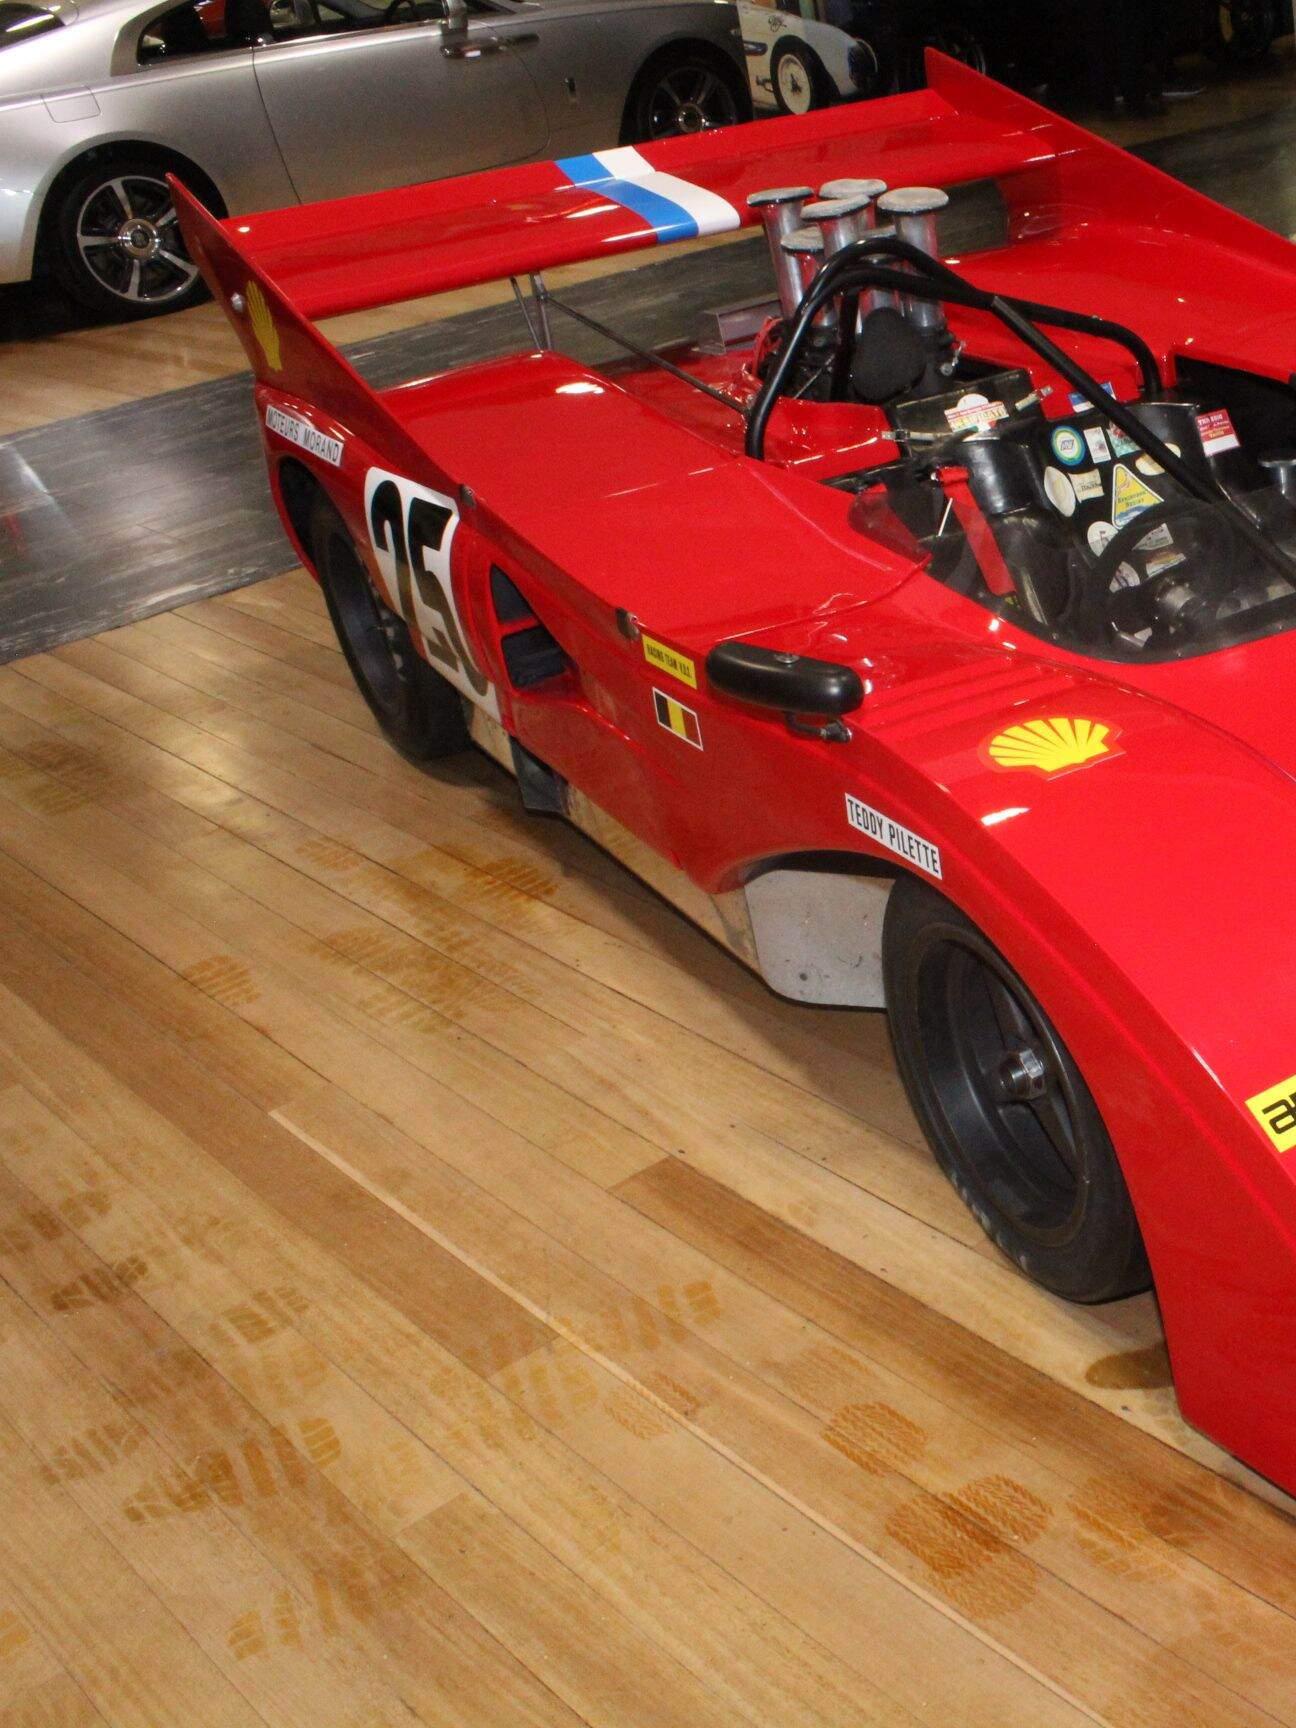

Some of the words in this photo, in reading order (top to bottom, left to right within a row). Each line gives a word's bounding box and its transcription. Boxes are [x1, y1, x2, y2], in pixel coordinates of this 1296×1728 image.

[267, 407, 300, 442] MOTEURS
[303, 427, 340, 463] MORAND
[370, 480, 489, 698] 25
[664, 653, 678, 670] TEAM
[847, 798, 884, 840] TEDDY
[888, 822, 939, 875] PILETTE
